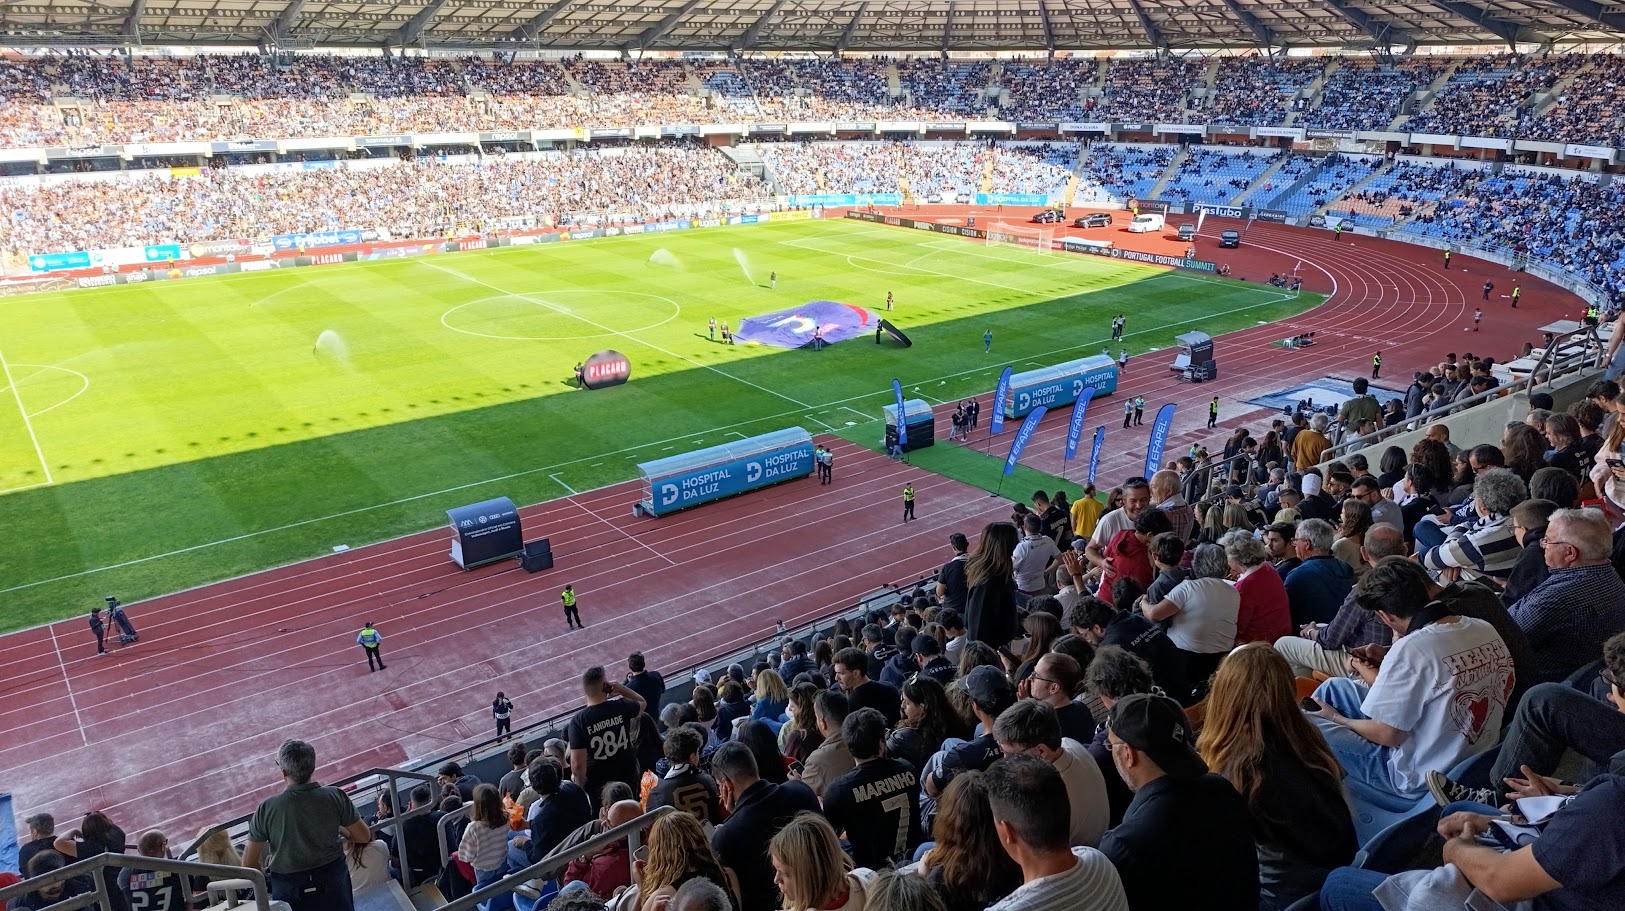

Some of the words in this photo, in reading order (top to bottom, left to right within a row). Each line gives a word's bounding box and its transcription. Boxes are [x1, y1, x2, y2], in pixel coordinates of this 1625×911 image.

[492, 132, 517, 141] repsol
[66, 145, 104, 157] repsol
[771, 212, 787, 220] Hertz
[792, 211, 808, 219] Hertz
[460, 240, 486, 250] PLACARD
[312, 254, 343, 264] PLACARD
[1123, 250, 1154, 263] PORTUGAL
[1155, 255, 1185, 267] FOOTBALL
[1186, 259, 1215, 271] SUMMIT
[186, 266, 216, 276] repsol
[590, 361, 626, 378] PLACARD
[1085, 371, 1114, 385] HOSPITAL
[996, 380, 1007, 417] EFAPEL
[1032, 384, 1064, 398] HOSPITAL
[1032, 398, 1042, 407] DA
[1042, 394, 1056, 405] LUZ
[1072, 401, 1086, 440] EFAPEL
[1013, 419, 1037, 457] EFAPEL
[1151, 420, 1167, 462] EFAPEL
[765, 449, 809, 467] HOSPITAL
[765, 467, 779, 478] DA
[780, 462, 798, 475] LUZ
[682, 469, 731, 490] HOSPITAL
[683, 488, 698, 500] DA
[700, 482, 719, 496] LUZ
[1442, 639, 1506, 676] HEART
[587, 715, 624, 735] F.ANDRADE
[590, 725, 629, 760] 284
[852, 770, 916, 803] MARINHO
[881, 793, 910, 855] 7
[131, 886, 173, 911] 23
